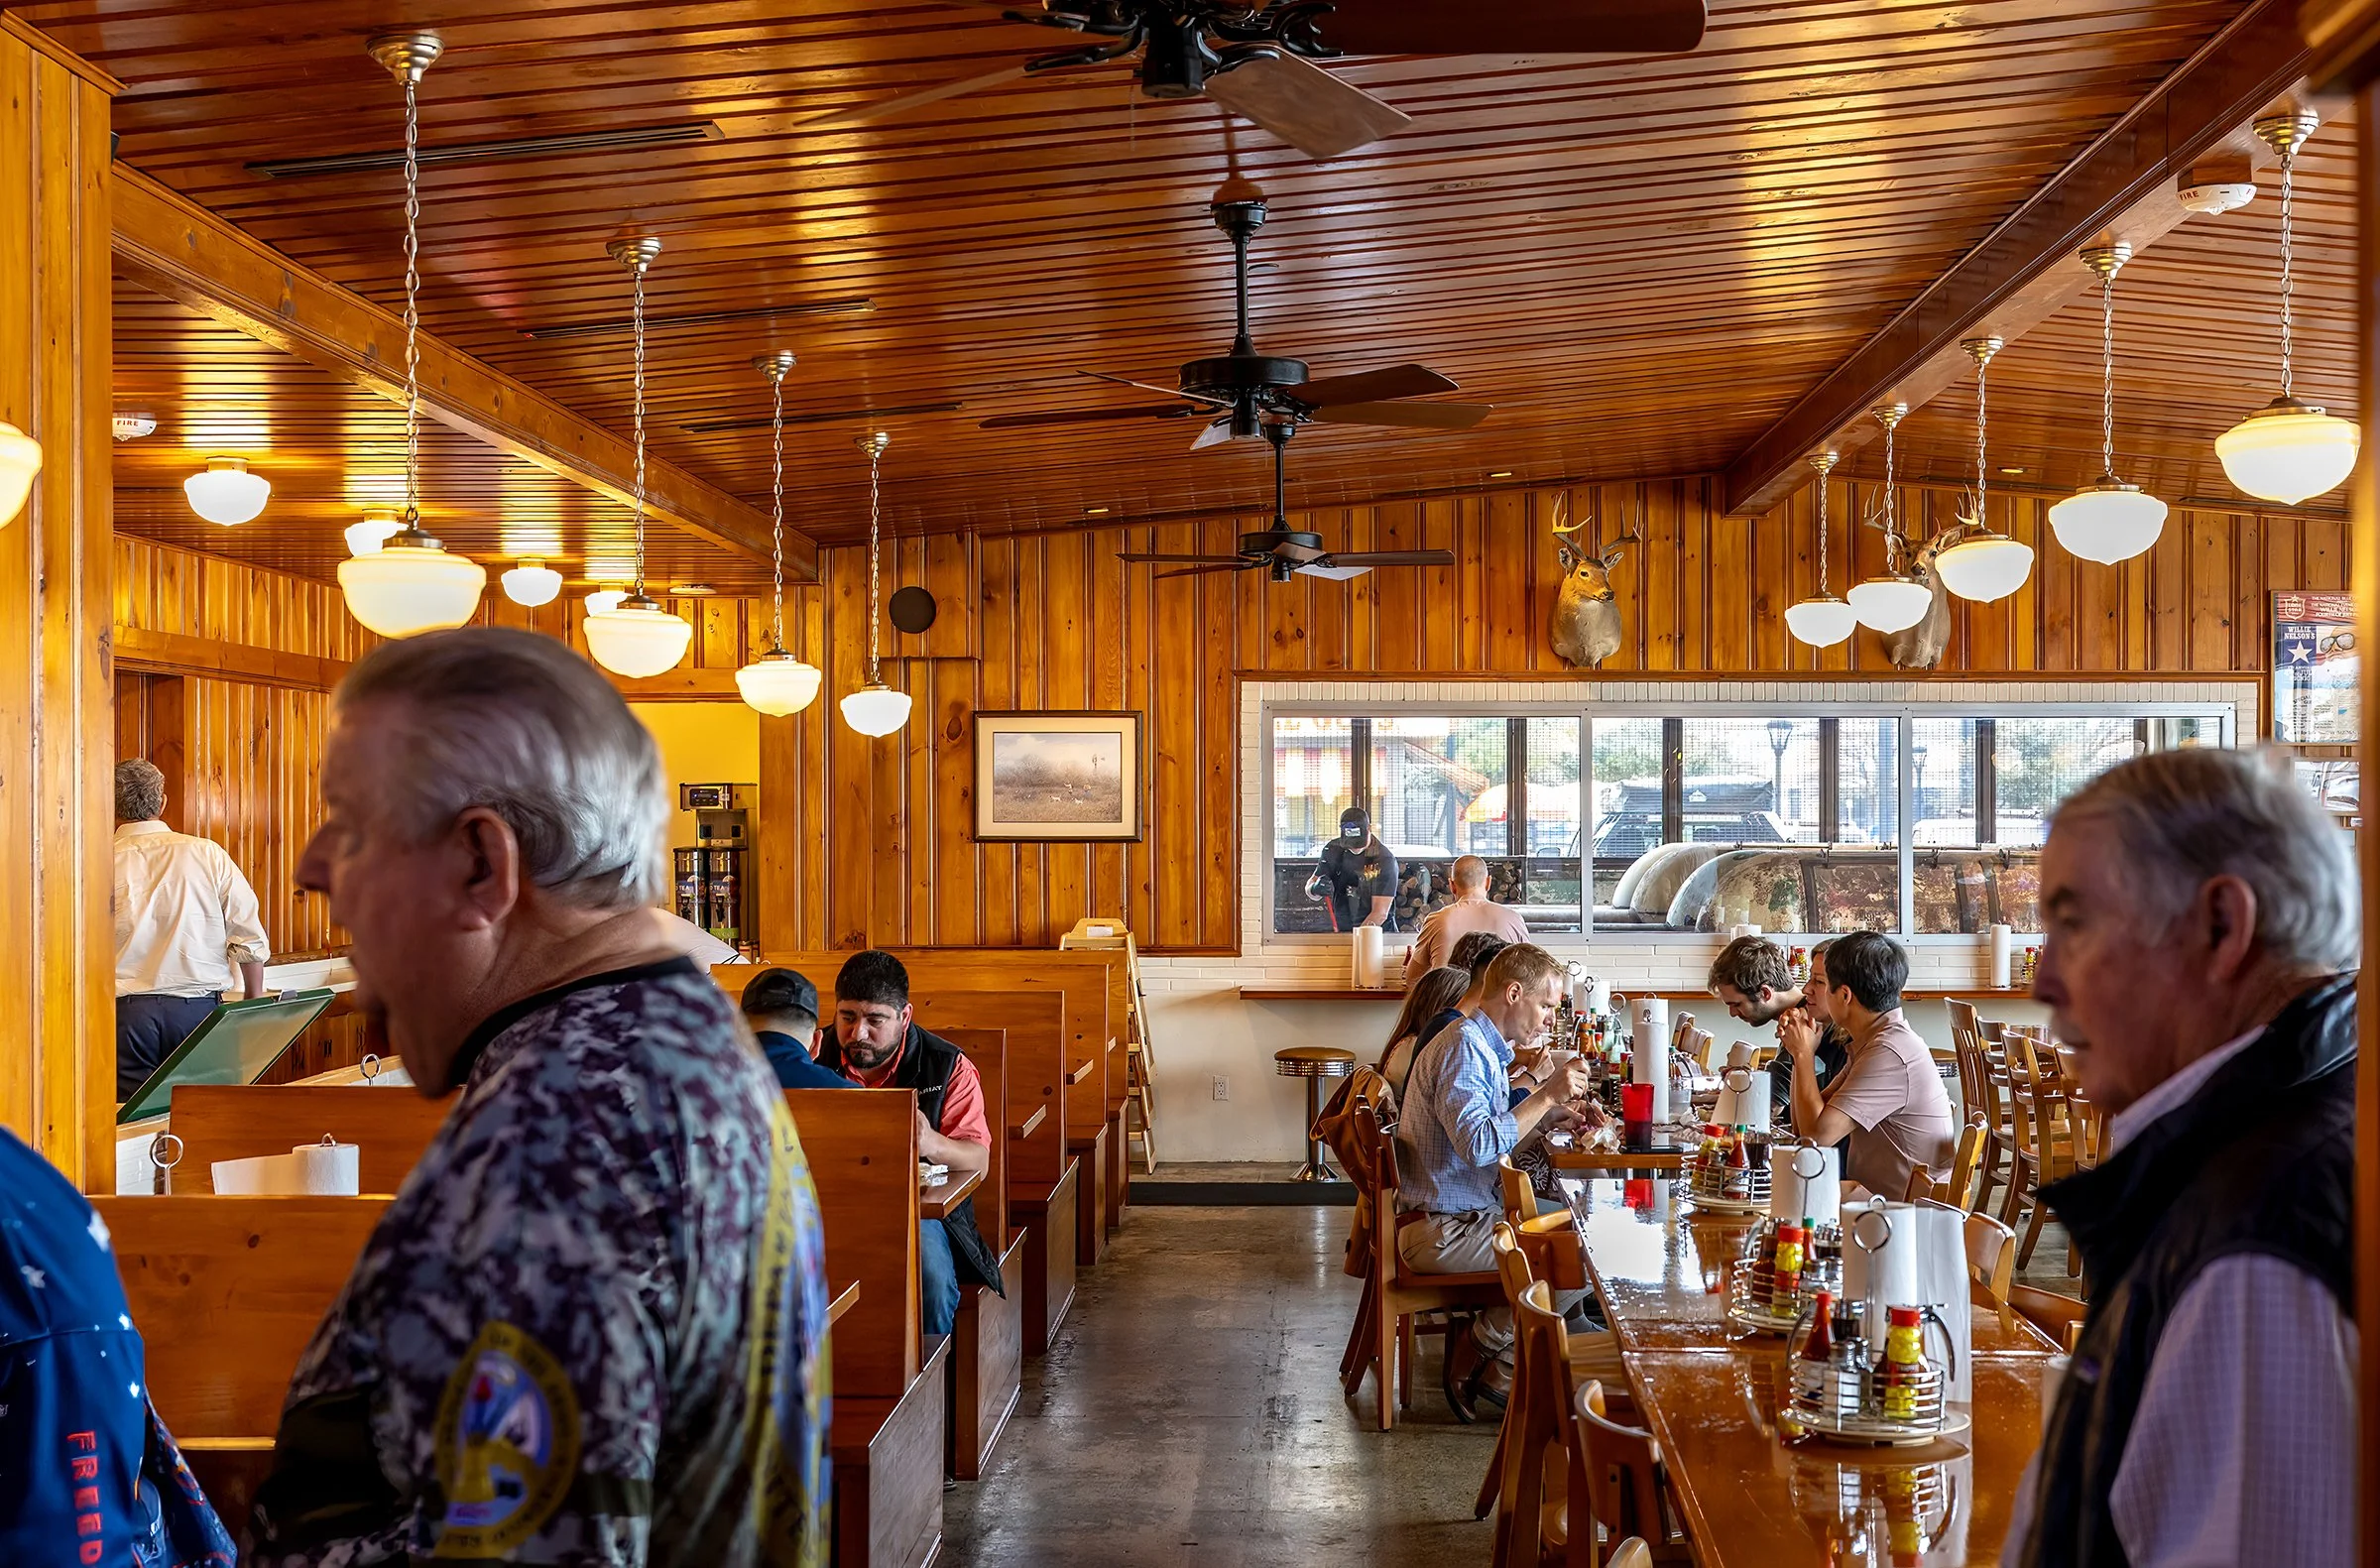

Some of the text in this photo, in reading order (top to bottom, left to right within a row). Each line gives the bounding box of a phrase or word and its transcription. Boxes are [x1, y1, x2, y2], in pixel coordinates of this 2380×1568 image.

[2179, 190, 2200, 201] FIRE
[918, 1085, 942, 1096] ARIAT
[66, 1430, 103, 1565] FREED
